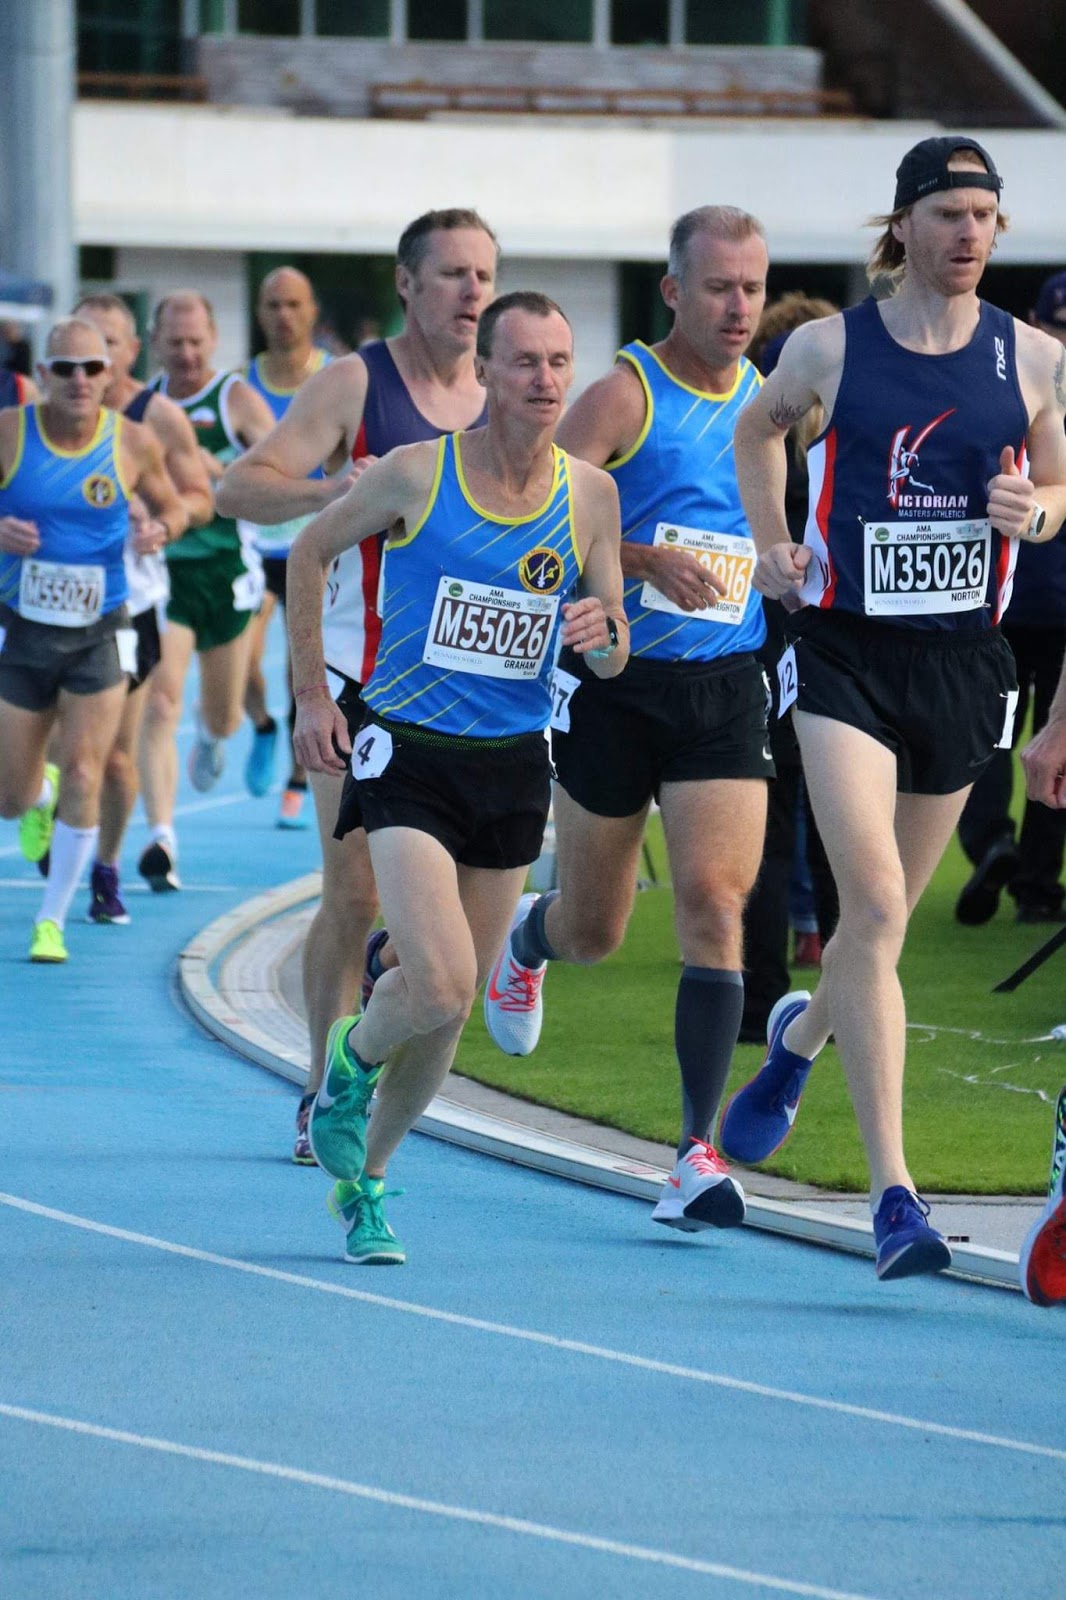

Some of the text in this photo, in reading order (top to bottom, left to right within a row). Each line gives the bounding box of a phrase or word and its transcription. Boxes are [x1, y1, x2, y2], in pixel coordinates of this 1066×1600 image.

[994, 336, 1007, 381] 2XU
[898, 509, 967, 519] MASTERS ATHLETICS
[916, 524, 932, 533] AMA
[701, 533, 715, 542] AMA
[896, 532, 952, 542] CHAMPIONSHIPS
[683, 538, 728, 552] CHAMPIONSHIPS
[874, 542, 983, 592] M35026
[489, 589, 505, 598] AMA
[950, 589, 981, 602] NORTON
[468, 593, 521, 609] CHAMPIONSHIPS
[436, 600, 548, 658] M55026
[504, 659, 537, 670] GRAHAM
[781, 660, 795, 700] 12
[357, 736, 376, 767] 4
